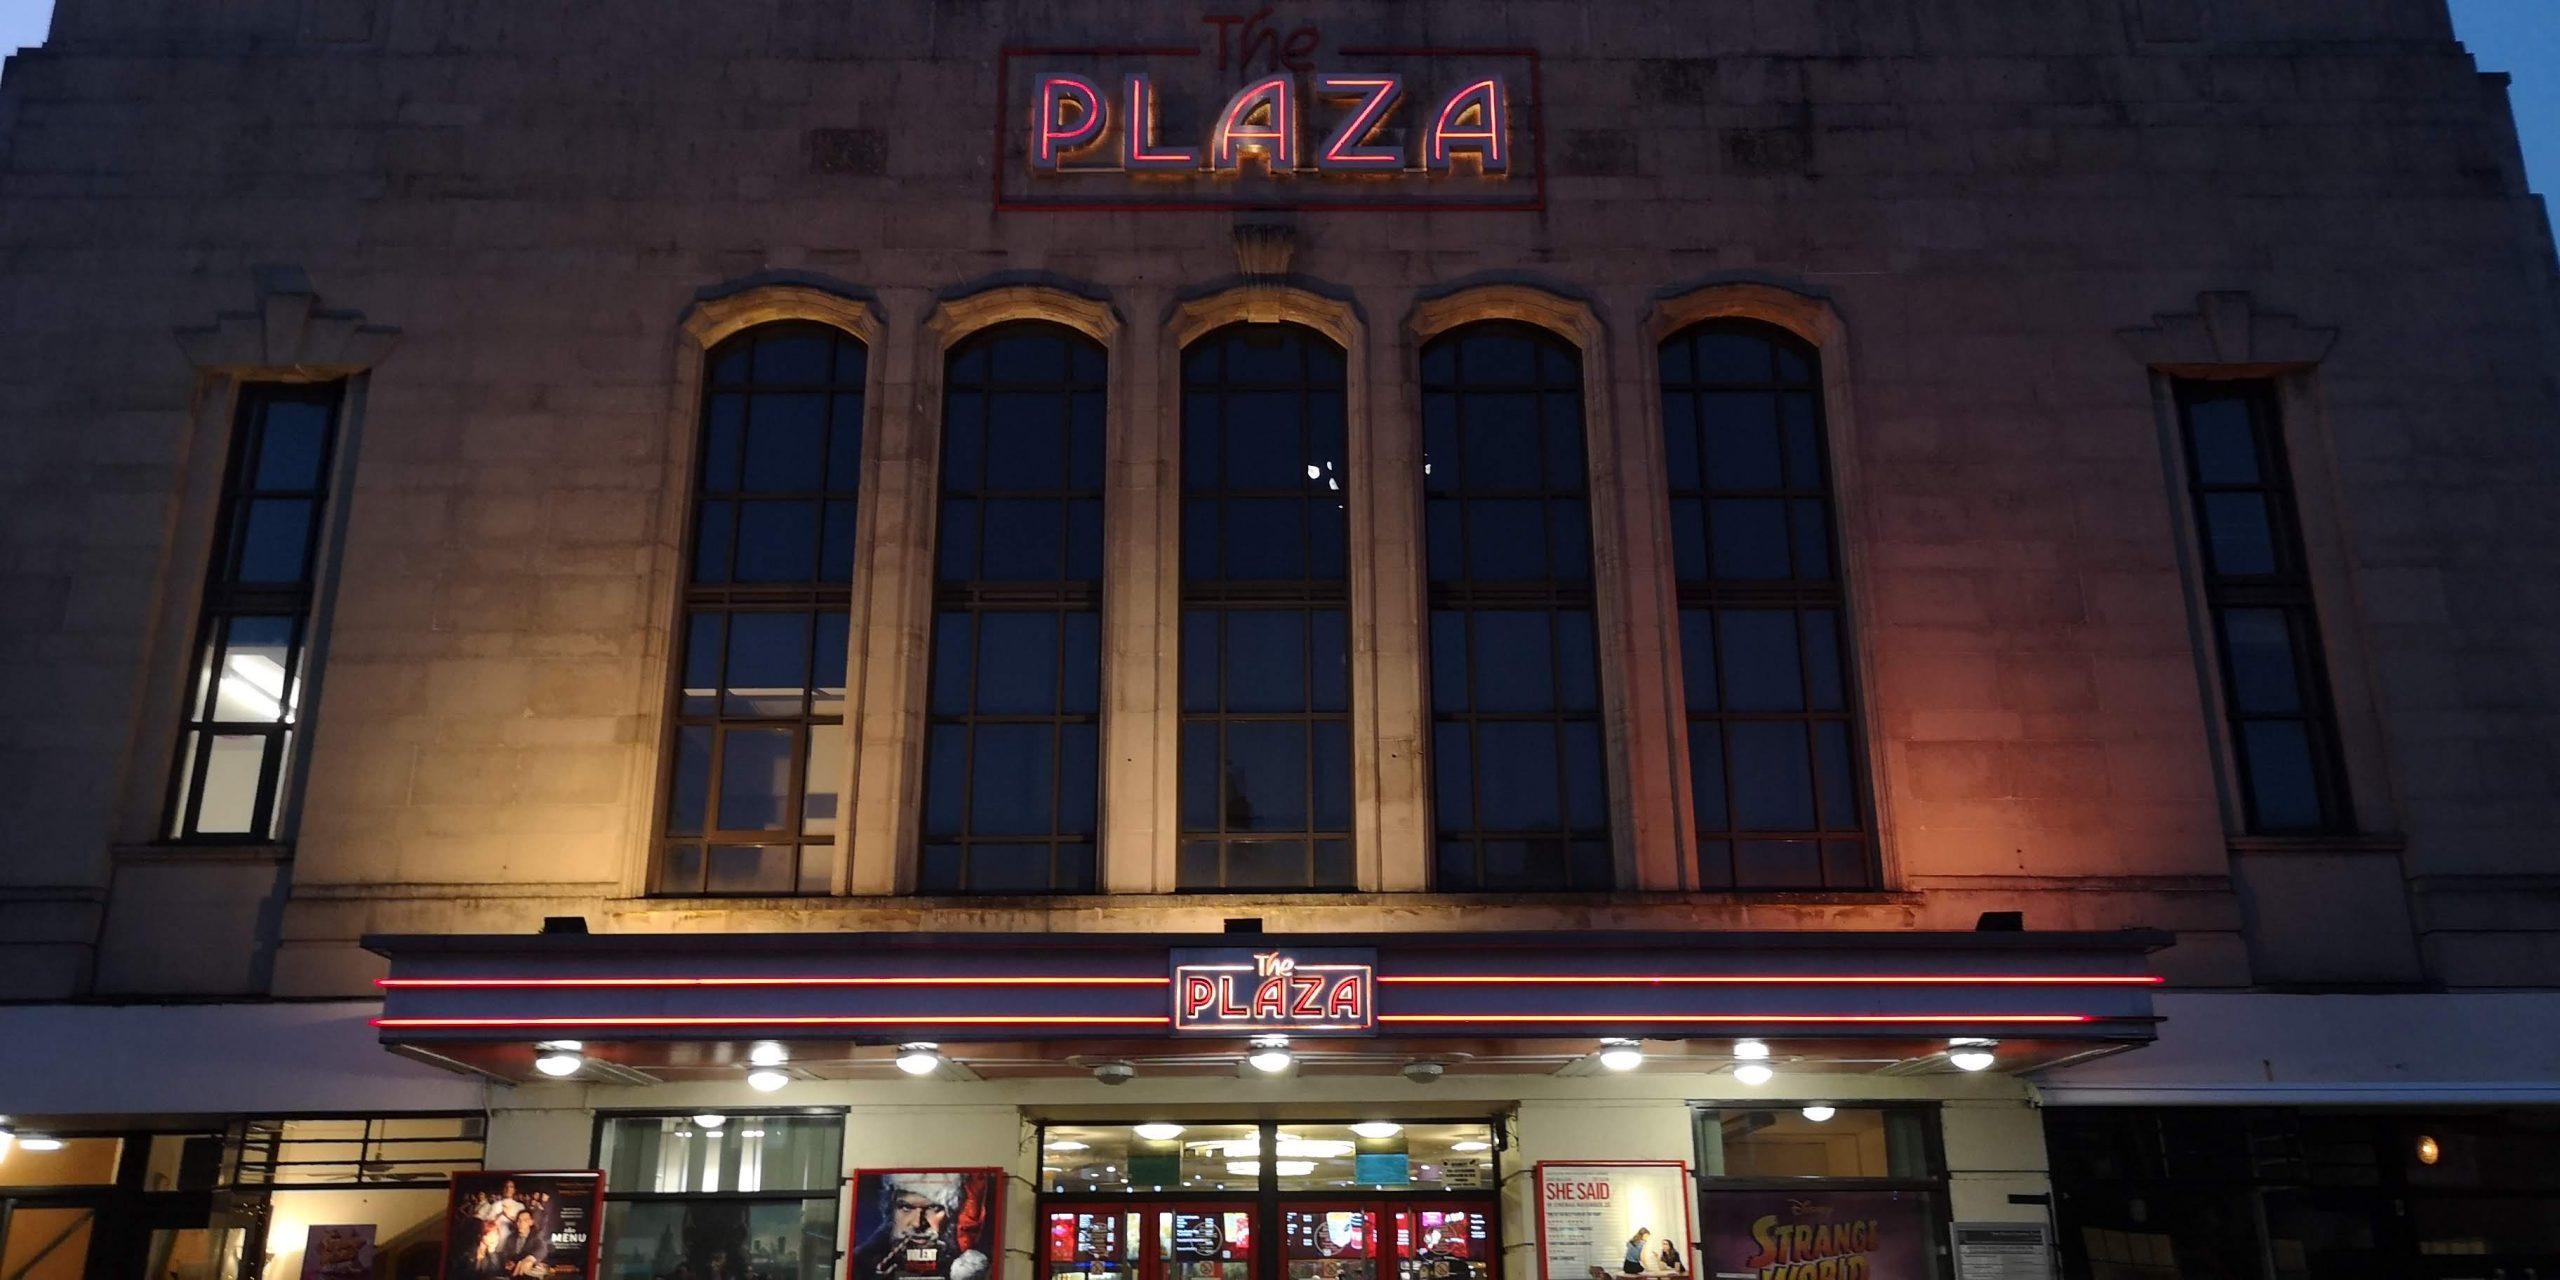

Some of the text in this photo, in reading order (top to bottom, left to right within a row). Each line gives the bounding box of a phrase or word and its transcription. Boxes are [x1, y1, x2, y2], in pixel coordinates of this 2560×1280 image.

[1202, 7, 1320, 75] The
[1033, 73, 1508, 174] PLAZA
[1253, 951, 1295, 977] The
[1186, 976, 1361, 1019] PLAZA
[1546, 1182, 1610, 1200] SHE SAID
[551, 1233, 587, 1243] MENU
[1746, 1215, 1880, 1268] STRANGE
